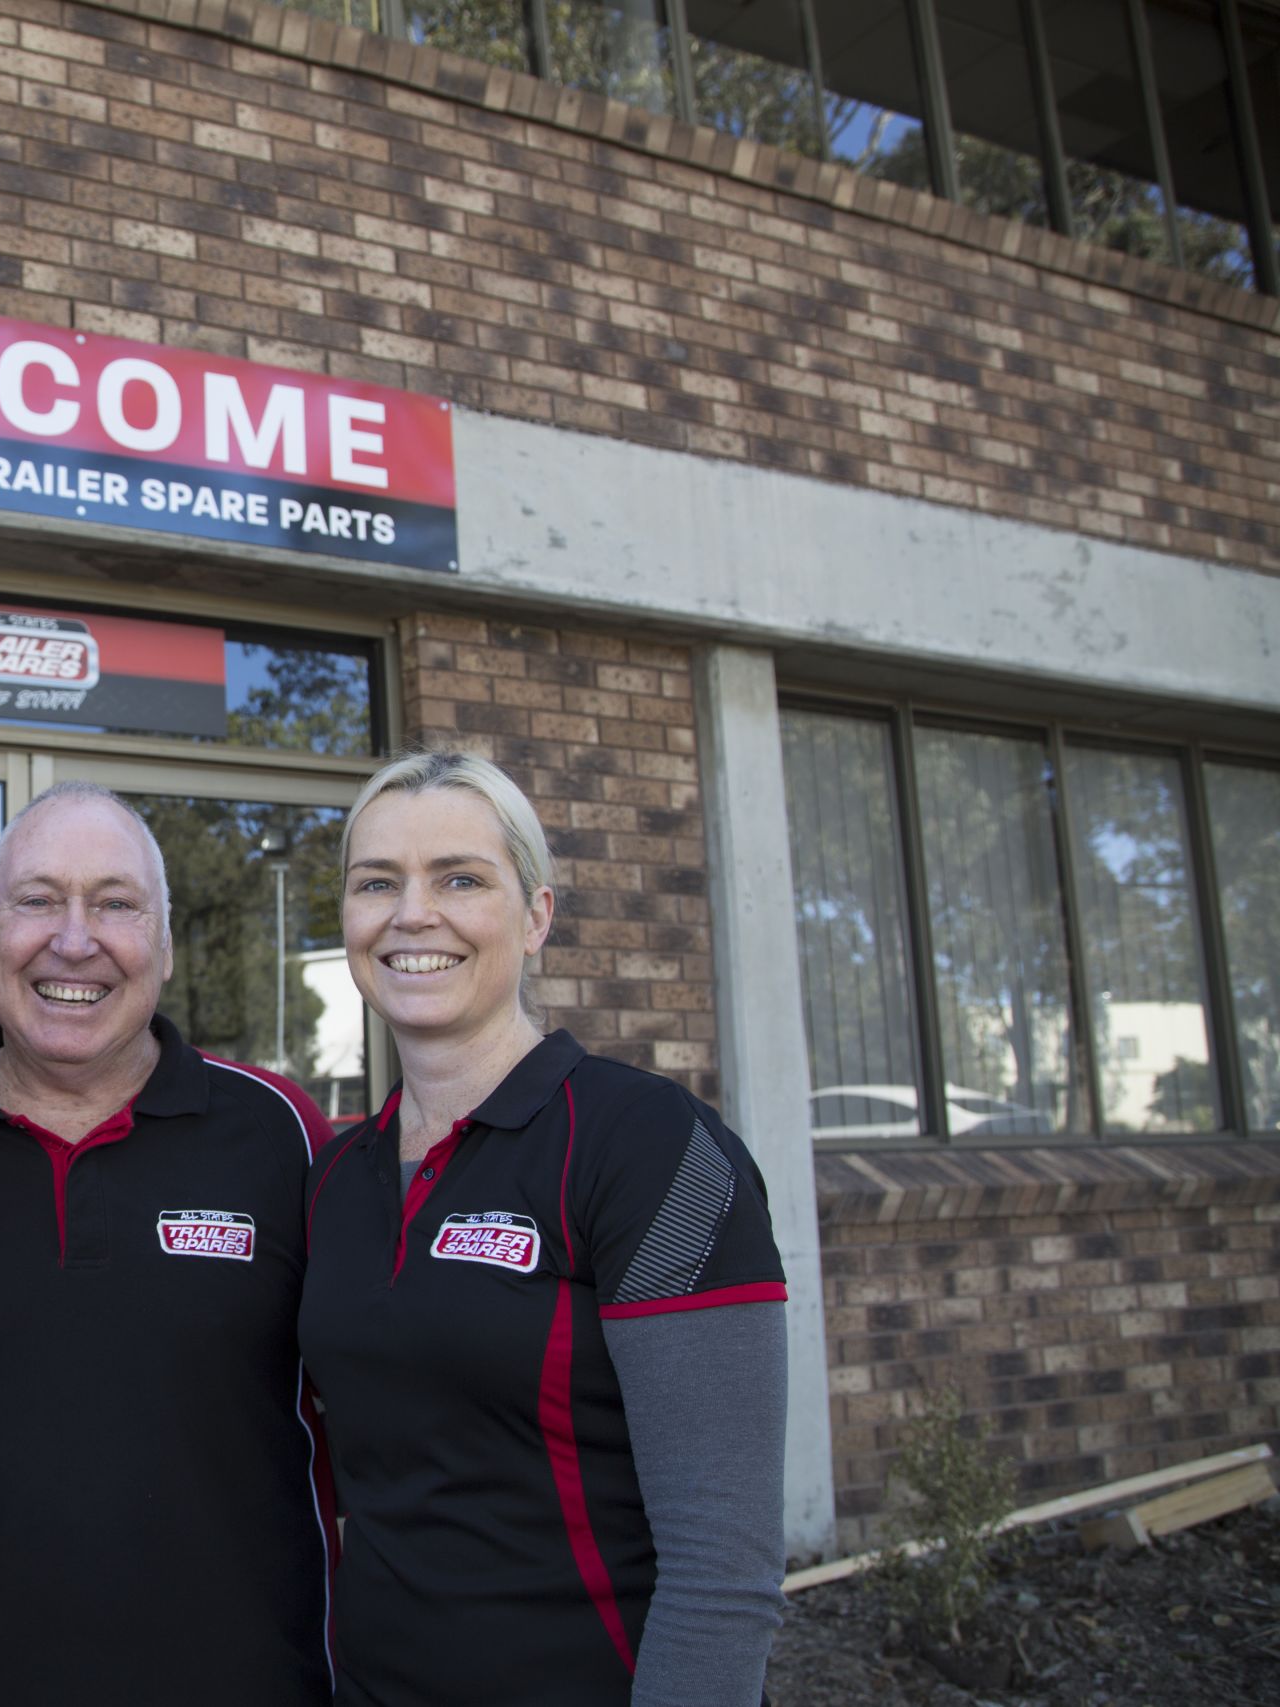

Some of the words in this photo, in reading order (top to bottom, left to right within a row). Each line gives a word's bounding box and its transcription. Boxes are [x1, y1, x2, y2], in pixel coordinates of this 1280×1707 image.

[141, 479, 269, 528] SPARE
[280, 502, 396, 546] PARTS
[8, 615, 60, 631] STATES
[180, 1211, 199, 1221] ALL
[200, 1211, 235, 1223] STATES
[466, 1214, 481, 1224] ALL
[482, 1213, 513, 1225] STATES
[168, 1226, 250, 1243] TRAILER
[447, 1229, 531, 1250] TRAILER
[172, 1238, 247, 1255] SPARES
[442, 1241, 525, 1263] SPARES
